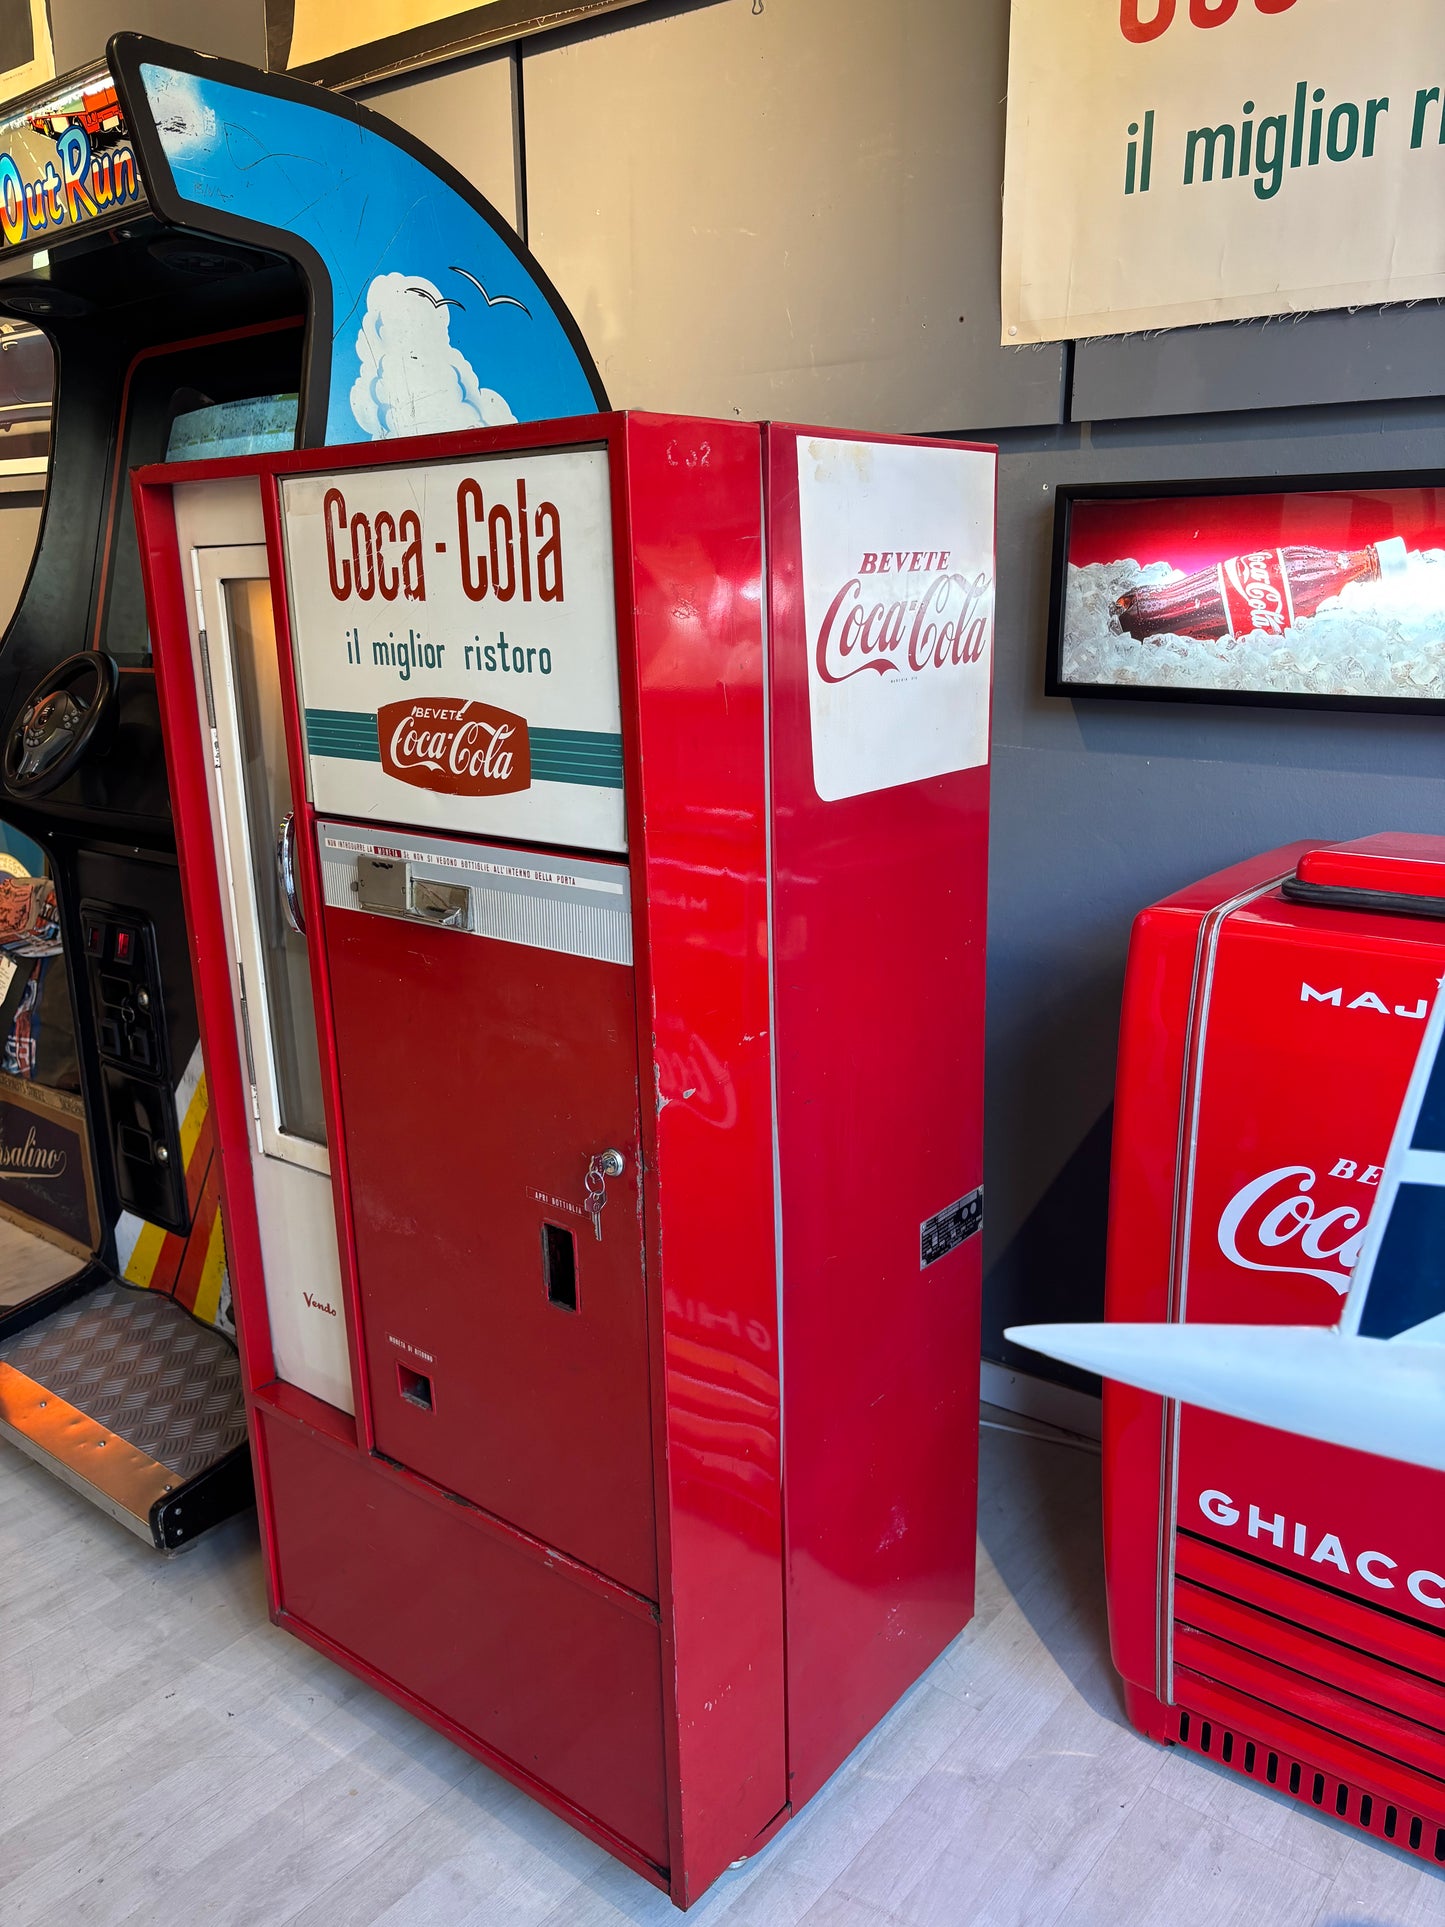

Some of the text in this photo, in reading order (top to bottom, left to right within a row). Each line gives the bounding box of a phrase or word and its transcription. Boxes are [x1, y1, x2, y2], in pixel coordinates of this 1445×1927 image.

[1125, 110, 1155, 195] il
[1183, 80, 1390, 200] miglior
[858, 551, 951, 575] BEVETE
[346, 628, 552, 681] il miglior ristoro
[415, 707, 464, 721] BEVETE
[328, 839, 576, 886] NON INTRODURRE LA MONETA SE NON SI VEDONO BOTTIGLIE ALL'INTERNO DELLA PORTA
[534, 1191, 582, 1215] APRI BOTTIGLIA
[303, 1291, 337, 1317] Vendo
[388, 1335, 433, 1363] MONETA DI RITORNO
[1198, 1489, 1445, 1609] GHIACC
